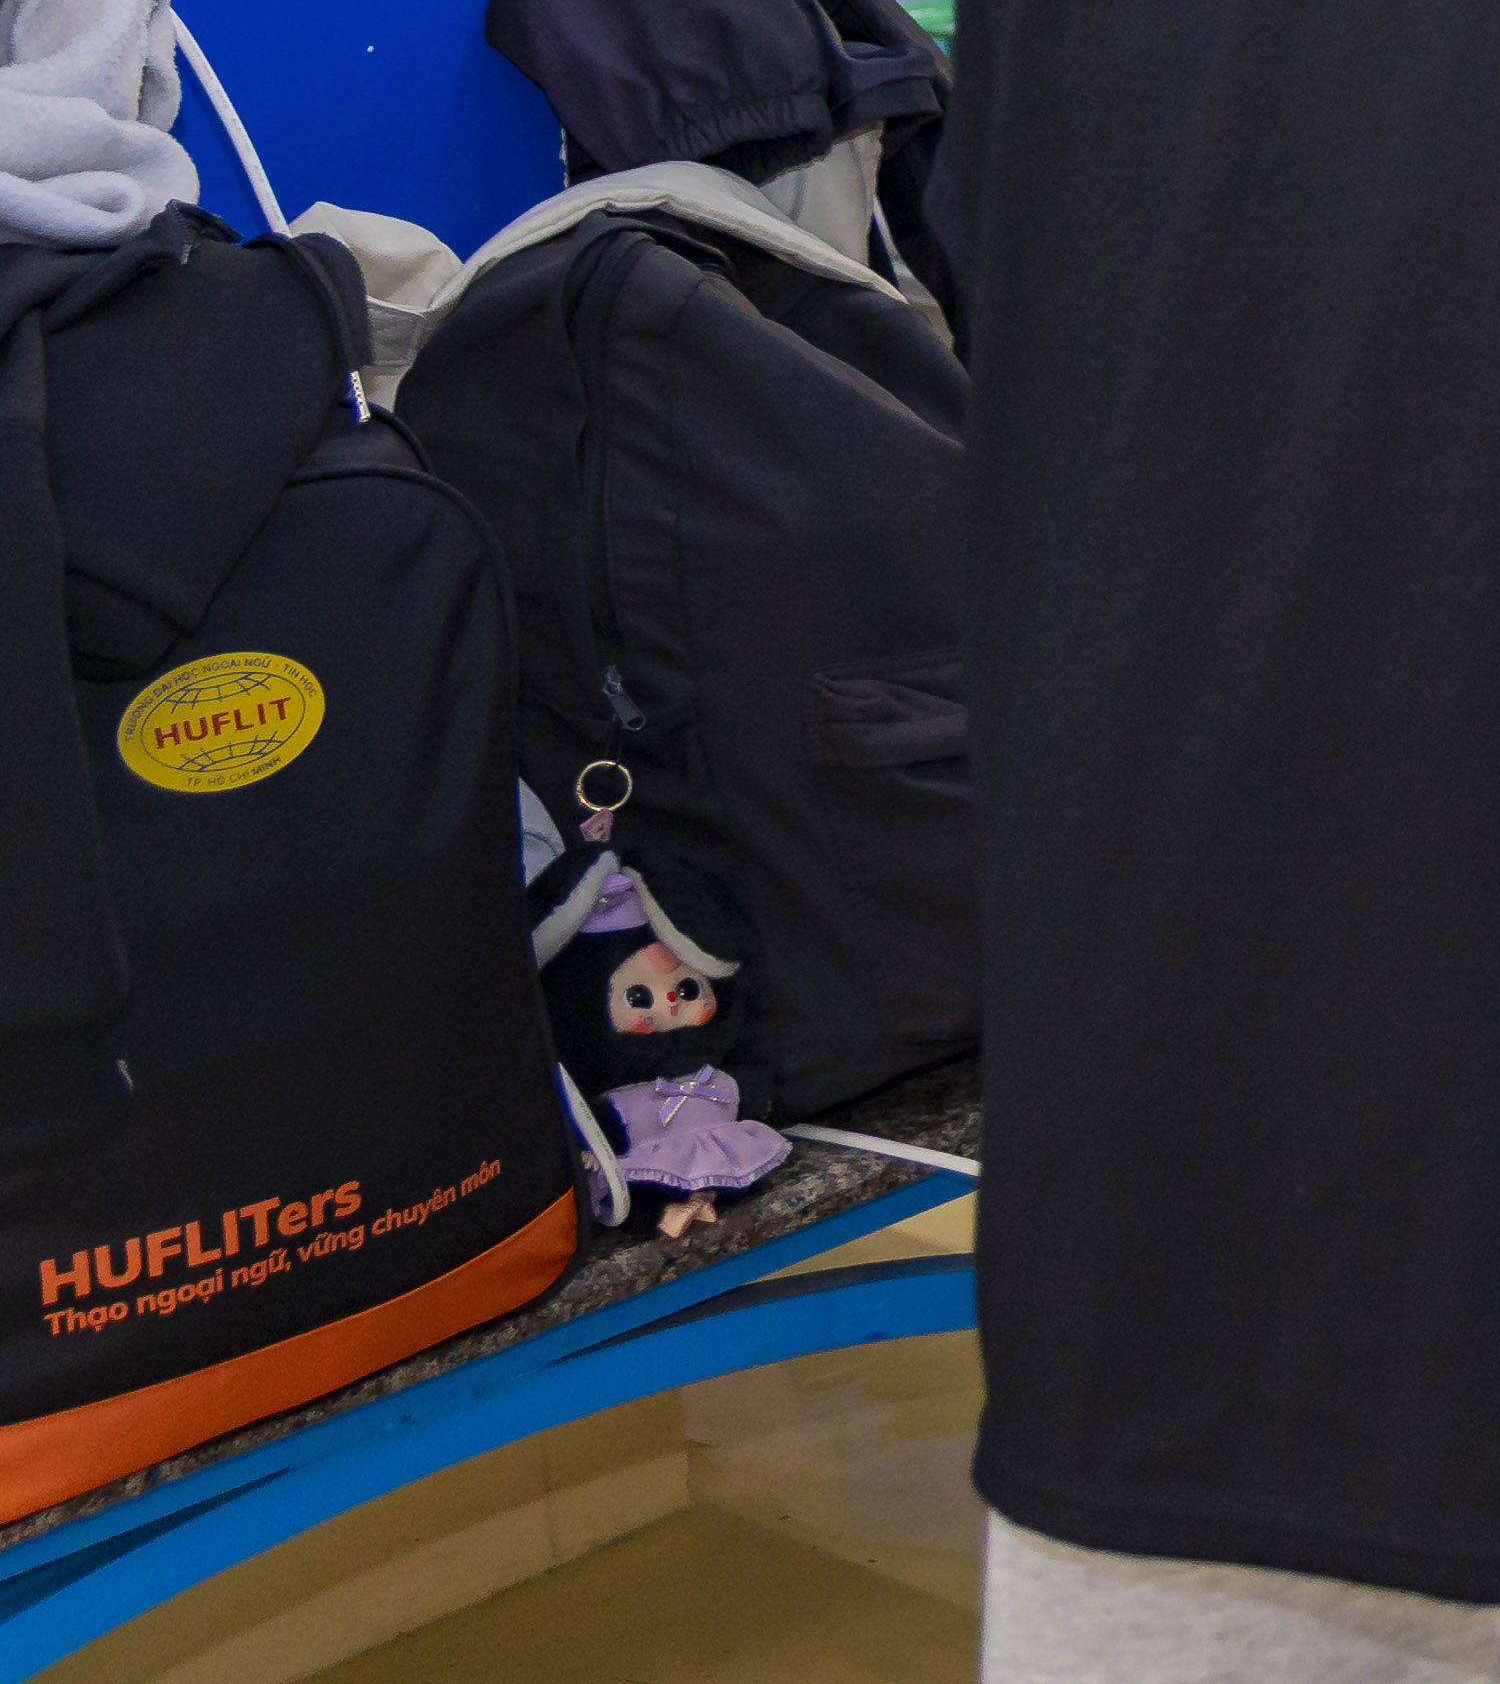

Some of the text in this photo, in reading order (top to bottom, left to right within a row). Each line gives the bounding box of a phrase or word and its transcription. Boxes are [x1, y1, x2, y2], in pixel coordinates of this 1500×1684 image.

[153, 696, 292, 750] HUFLIT
[250, 756, 282, 778] MINH
[39, 1179, 364, 1306] HUFLITers
[43, 1155, 502, 1336] Thạo ngoại ngữ, vững chuyên môn
